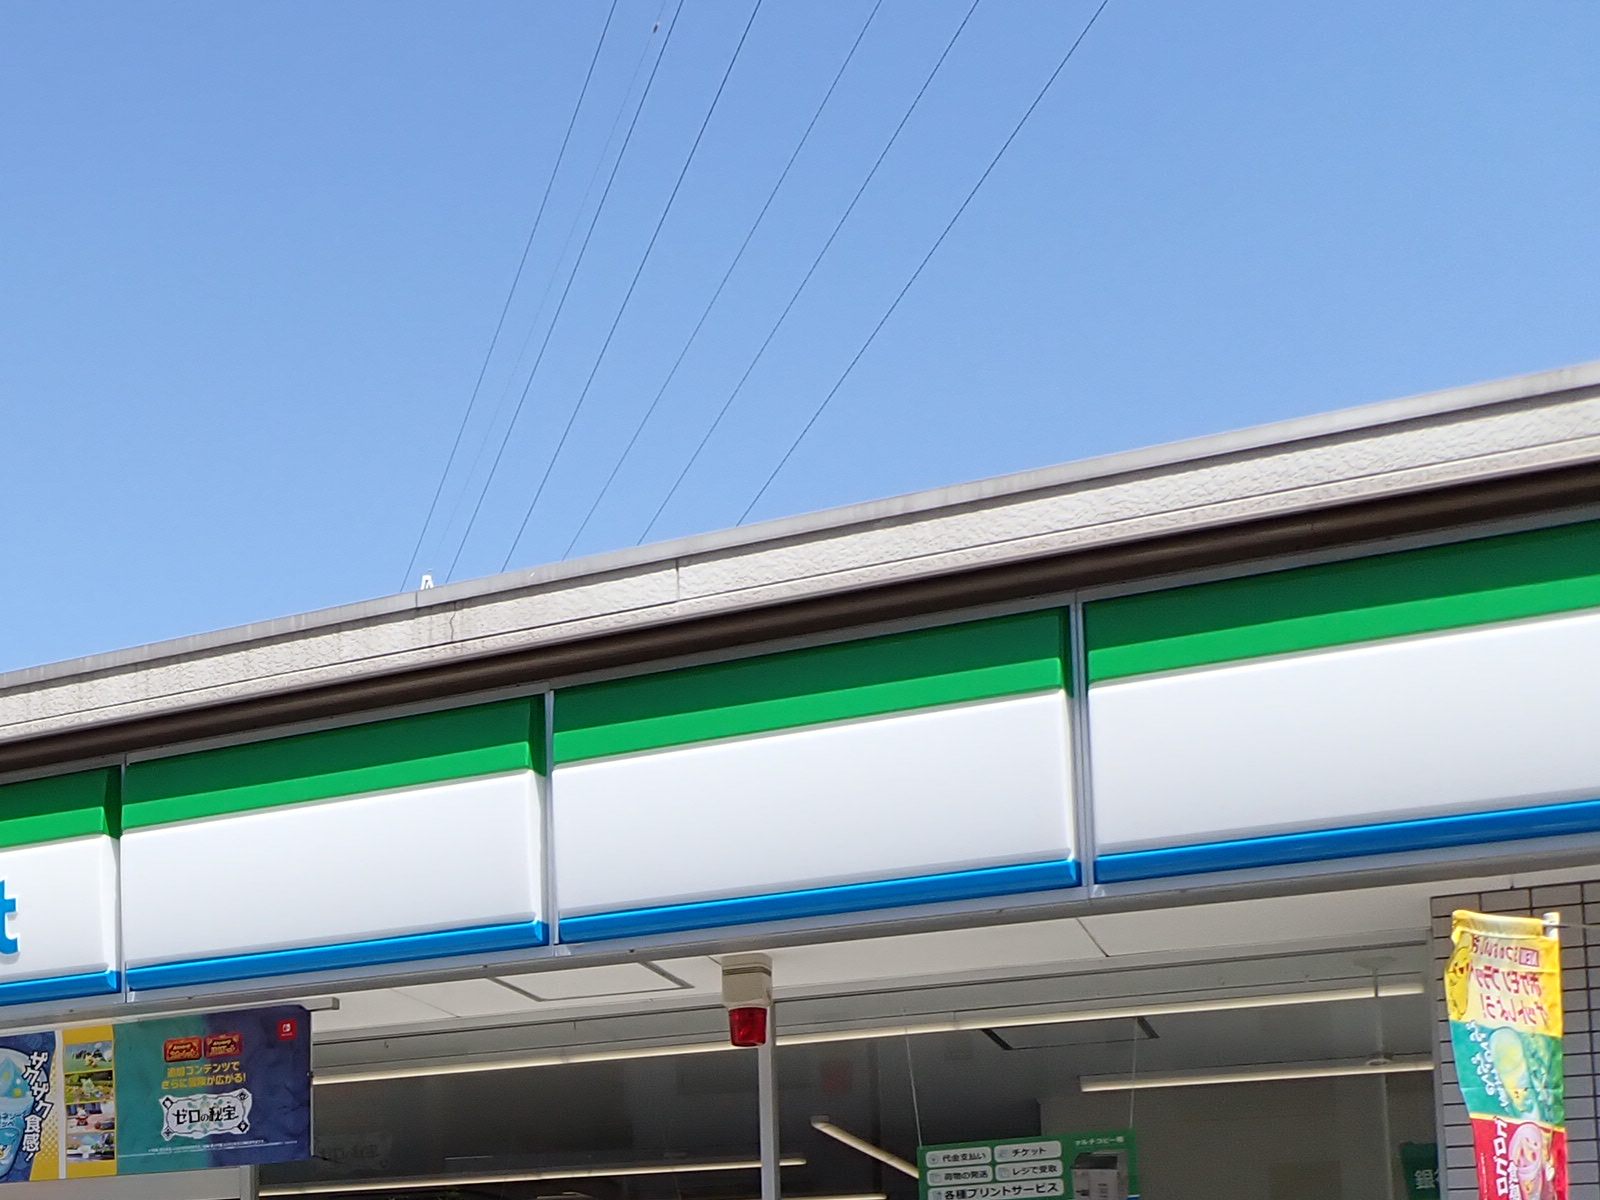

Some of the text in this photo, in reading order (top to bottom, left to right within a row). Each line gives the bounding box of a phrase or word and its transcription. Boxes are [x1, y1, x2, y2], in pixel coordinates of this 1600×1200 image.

[1012, 1146, 1046, 1158] チケット
[1414, 1168, 1439, 1190] 銀
[944, 1183, 1059, 1200] 各種プリントサービス
